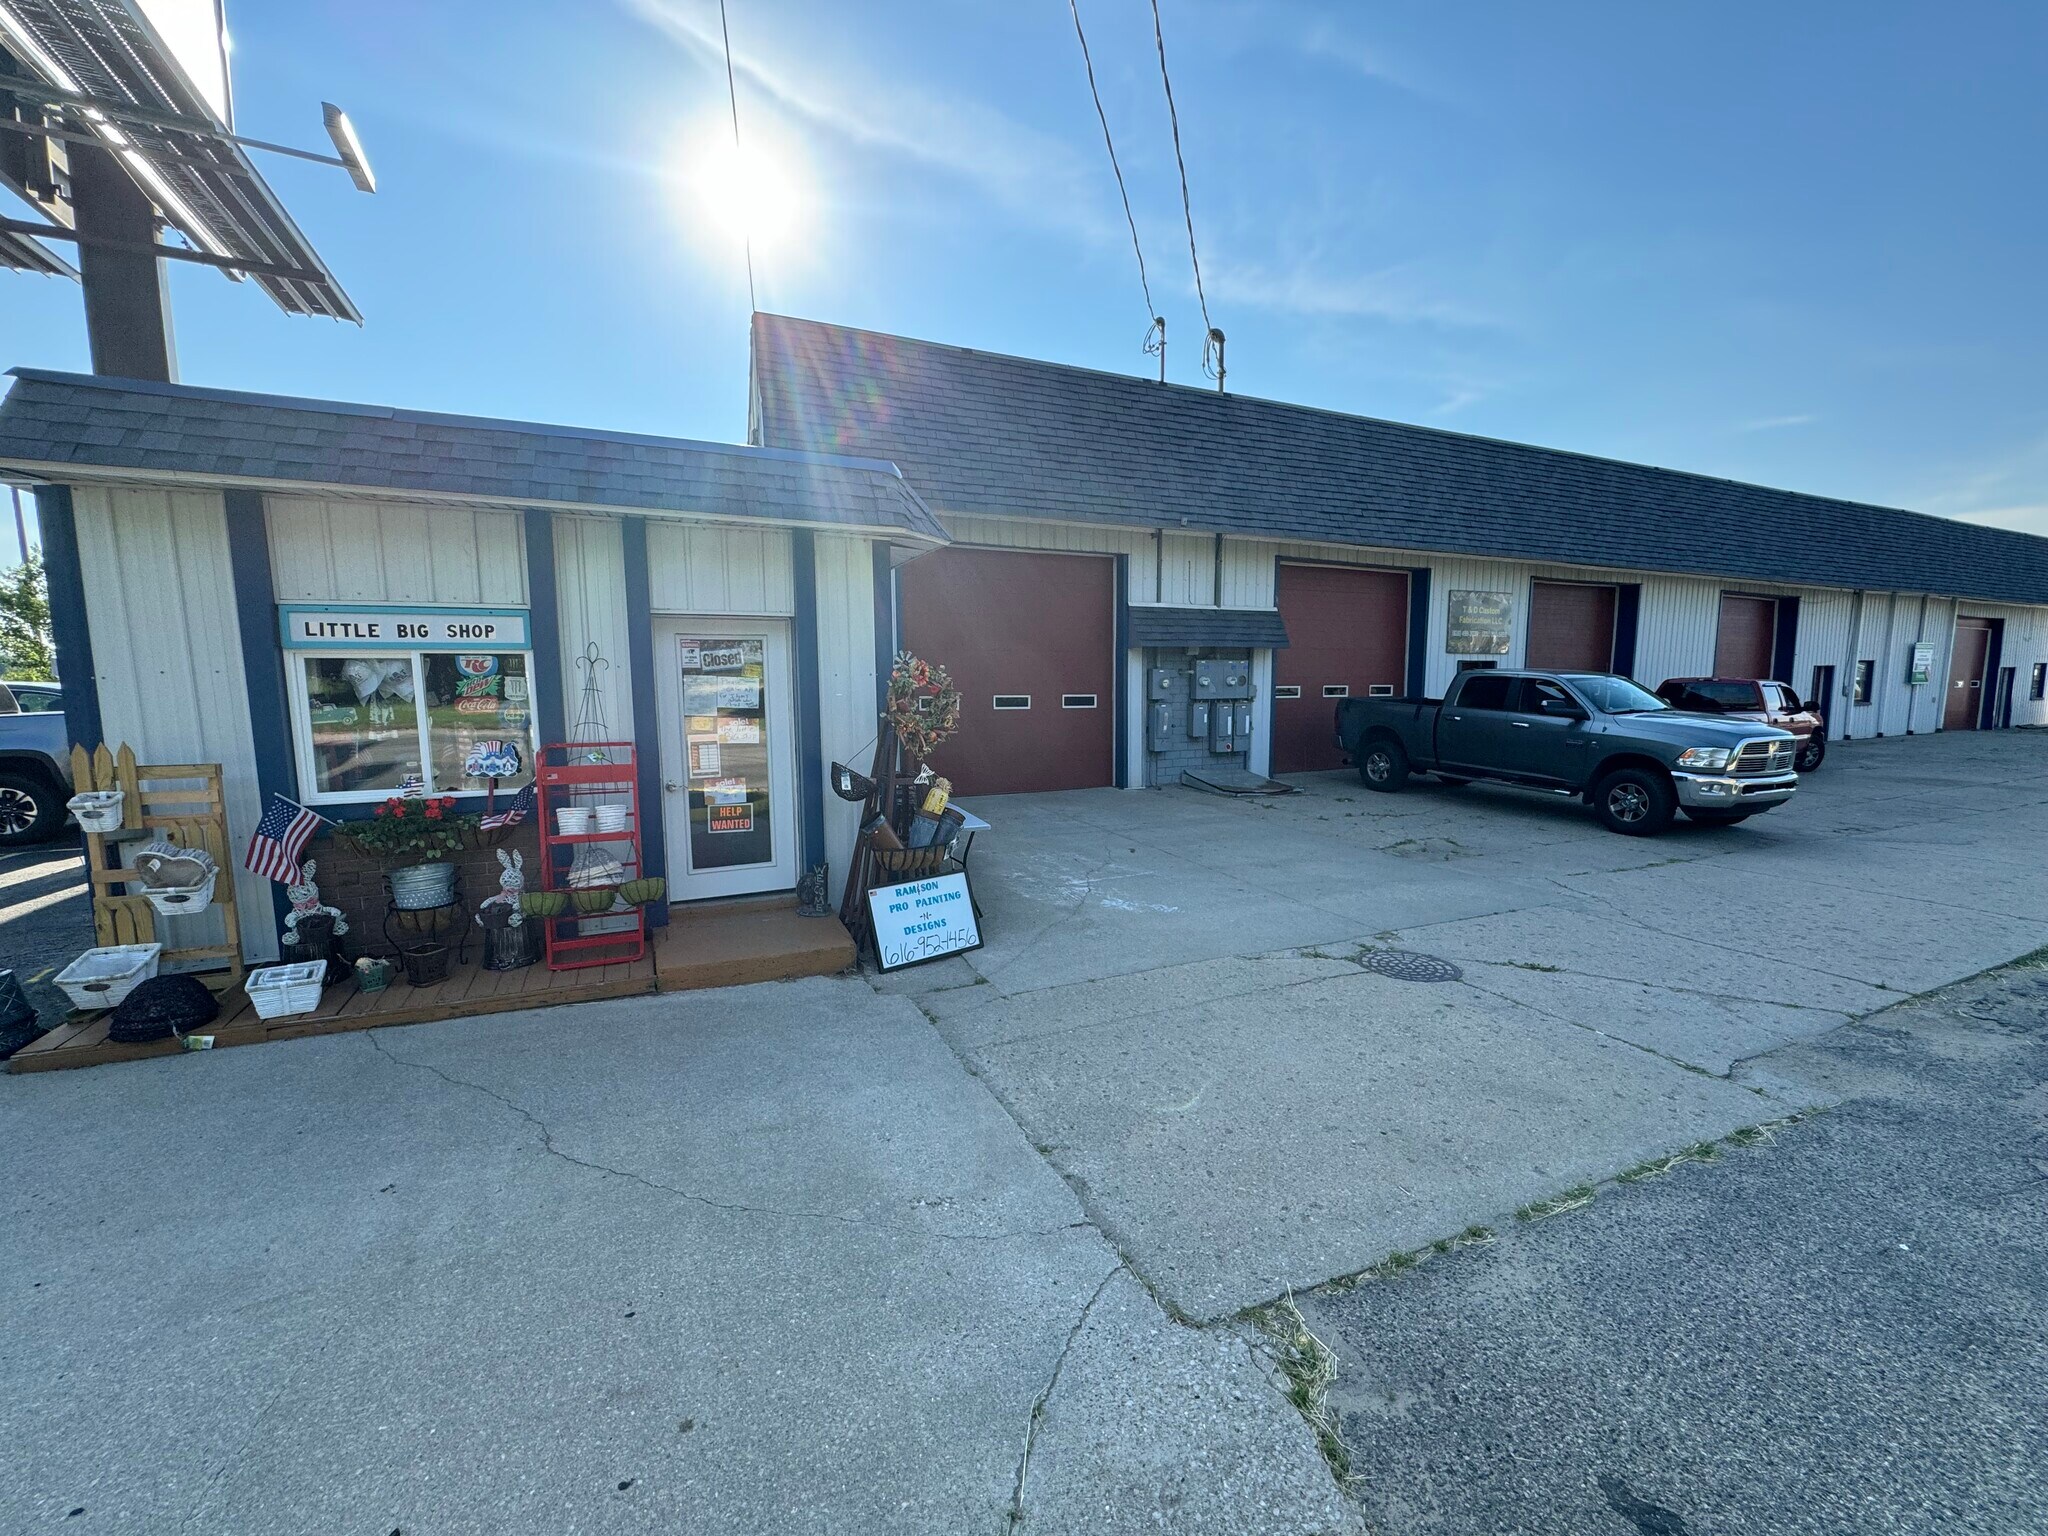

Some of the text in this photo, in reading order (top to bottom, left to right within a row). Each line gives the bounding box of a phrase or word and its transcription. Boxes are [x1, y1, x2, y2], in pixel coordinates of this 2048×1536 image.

[304, 621, 495, 638] LITTLE BIG SHOP
[461, 659, 491, 673] RC
[702, 652, 742, 668] Closed
[719, 806, 743, 817] HELP
[712, 818, 750, 830] WANTED
[889, 890, 962, 914] PRO PAINTING
[903, 918, 947, 936] DESIGNS
[884, 927, 977, 966] 616-952-1456
